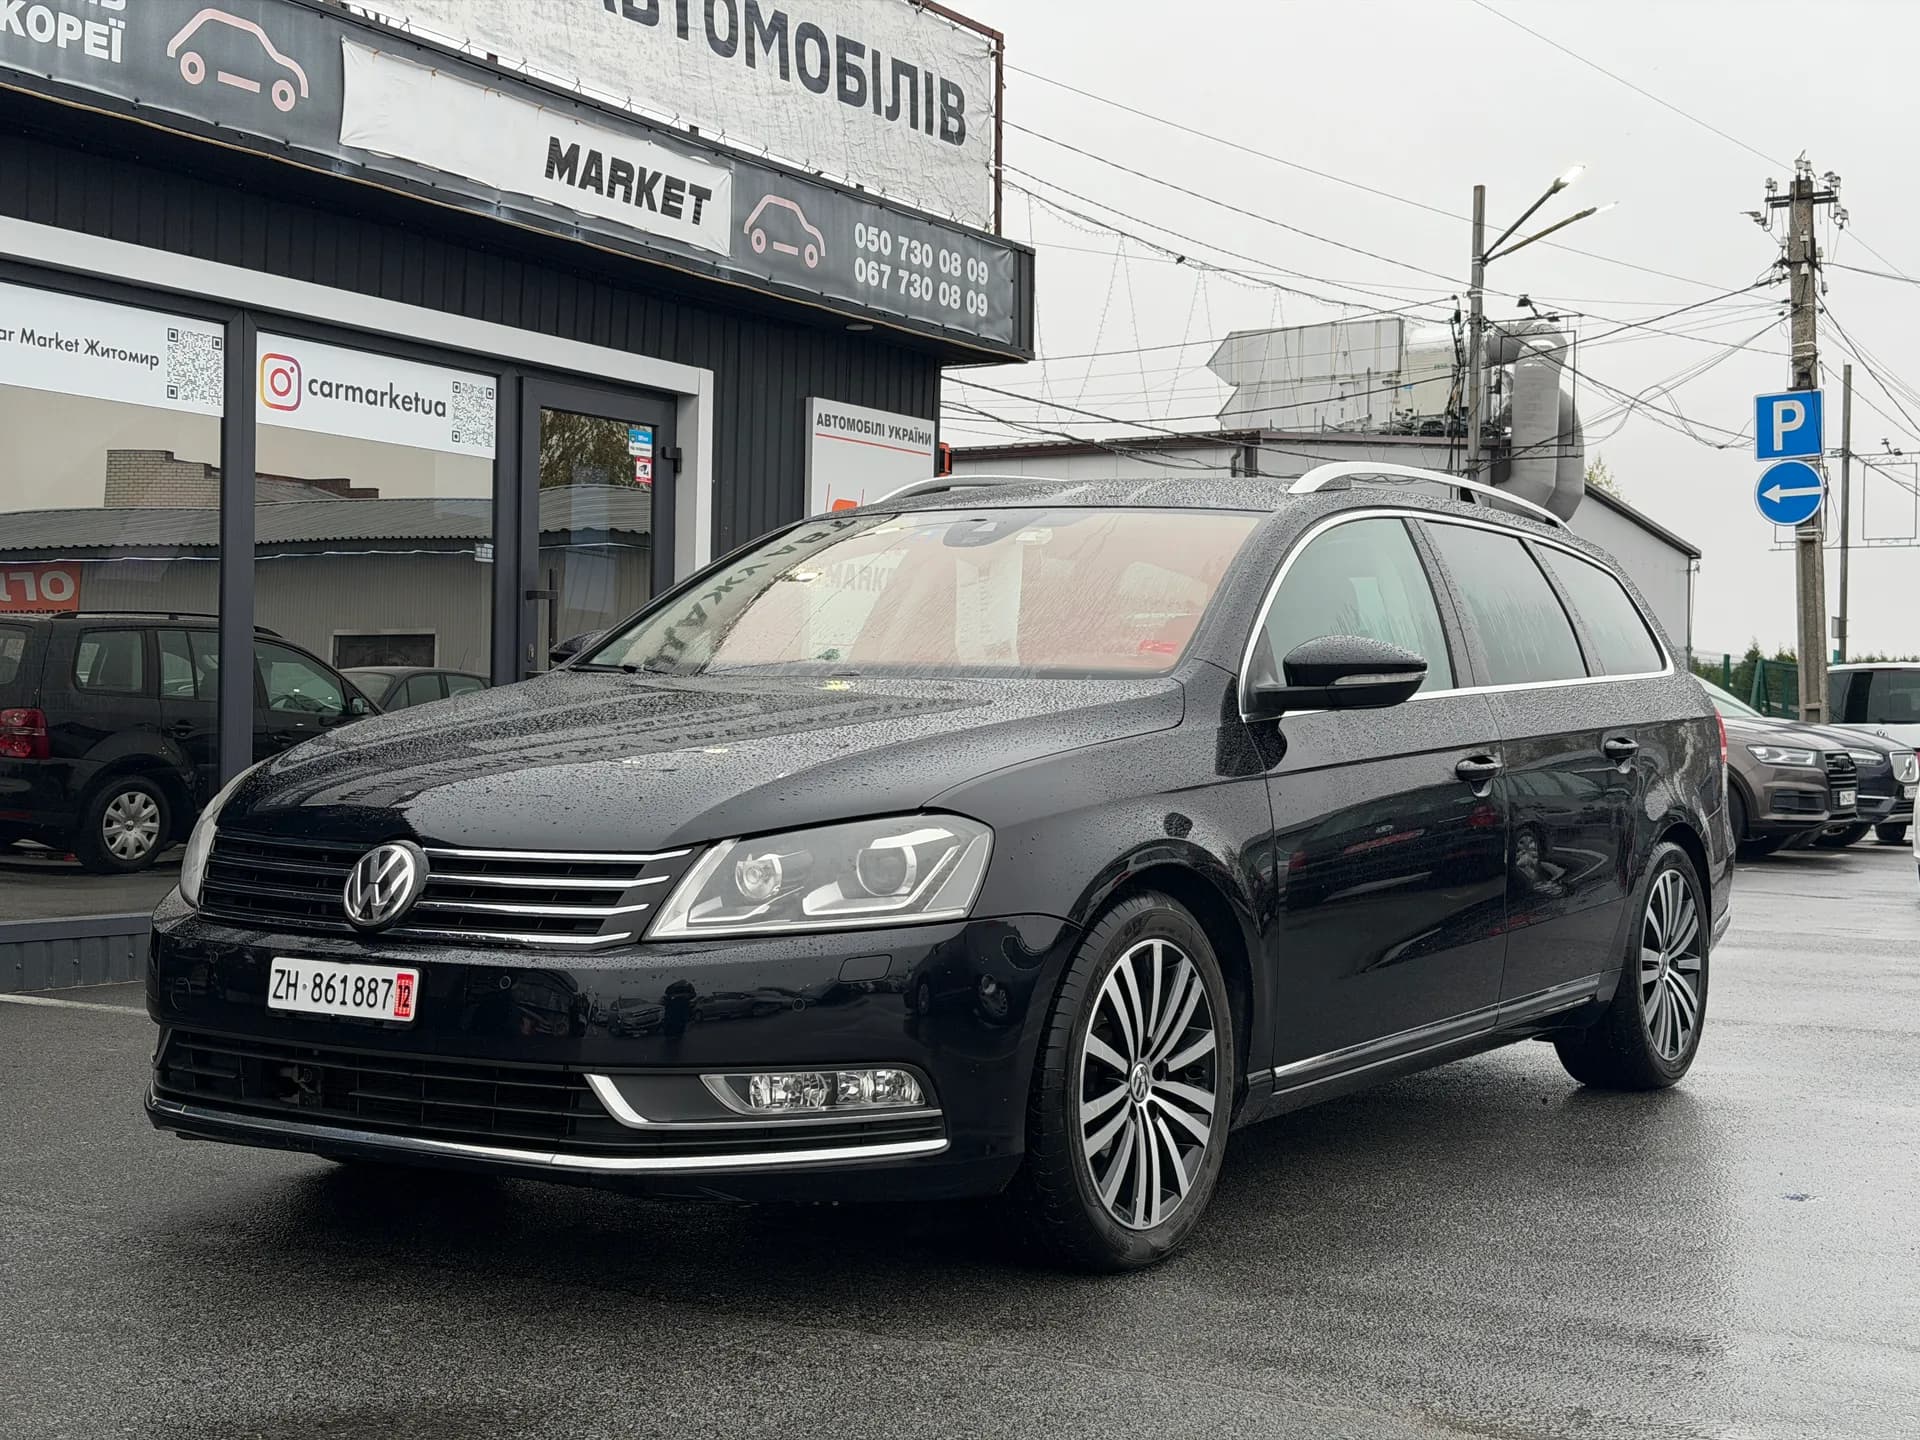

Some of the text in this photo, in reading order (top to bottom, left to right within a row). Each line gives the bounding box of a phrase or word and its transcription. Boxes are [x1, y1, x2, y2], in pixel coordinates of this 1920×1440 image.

[604, 0, 967, 147] ТОМОБІЛІВ
[544, 135, 713, 226] MARKET
[854, 222, 989, 285] 050 730 08 09
[854, 257, 988, 317] 067 730 08 09
[20, 327, 80, 353] Market
[84, 338, 160, 371] Житомир
[308, 378, 447, 418] carmarketua
[1773, 399, 1806, 451] P
[816, 412, 932, 446] АВТОМОБІЛІ УКРАЇНИ
